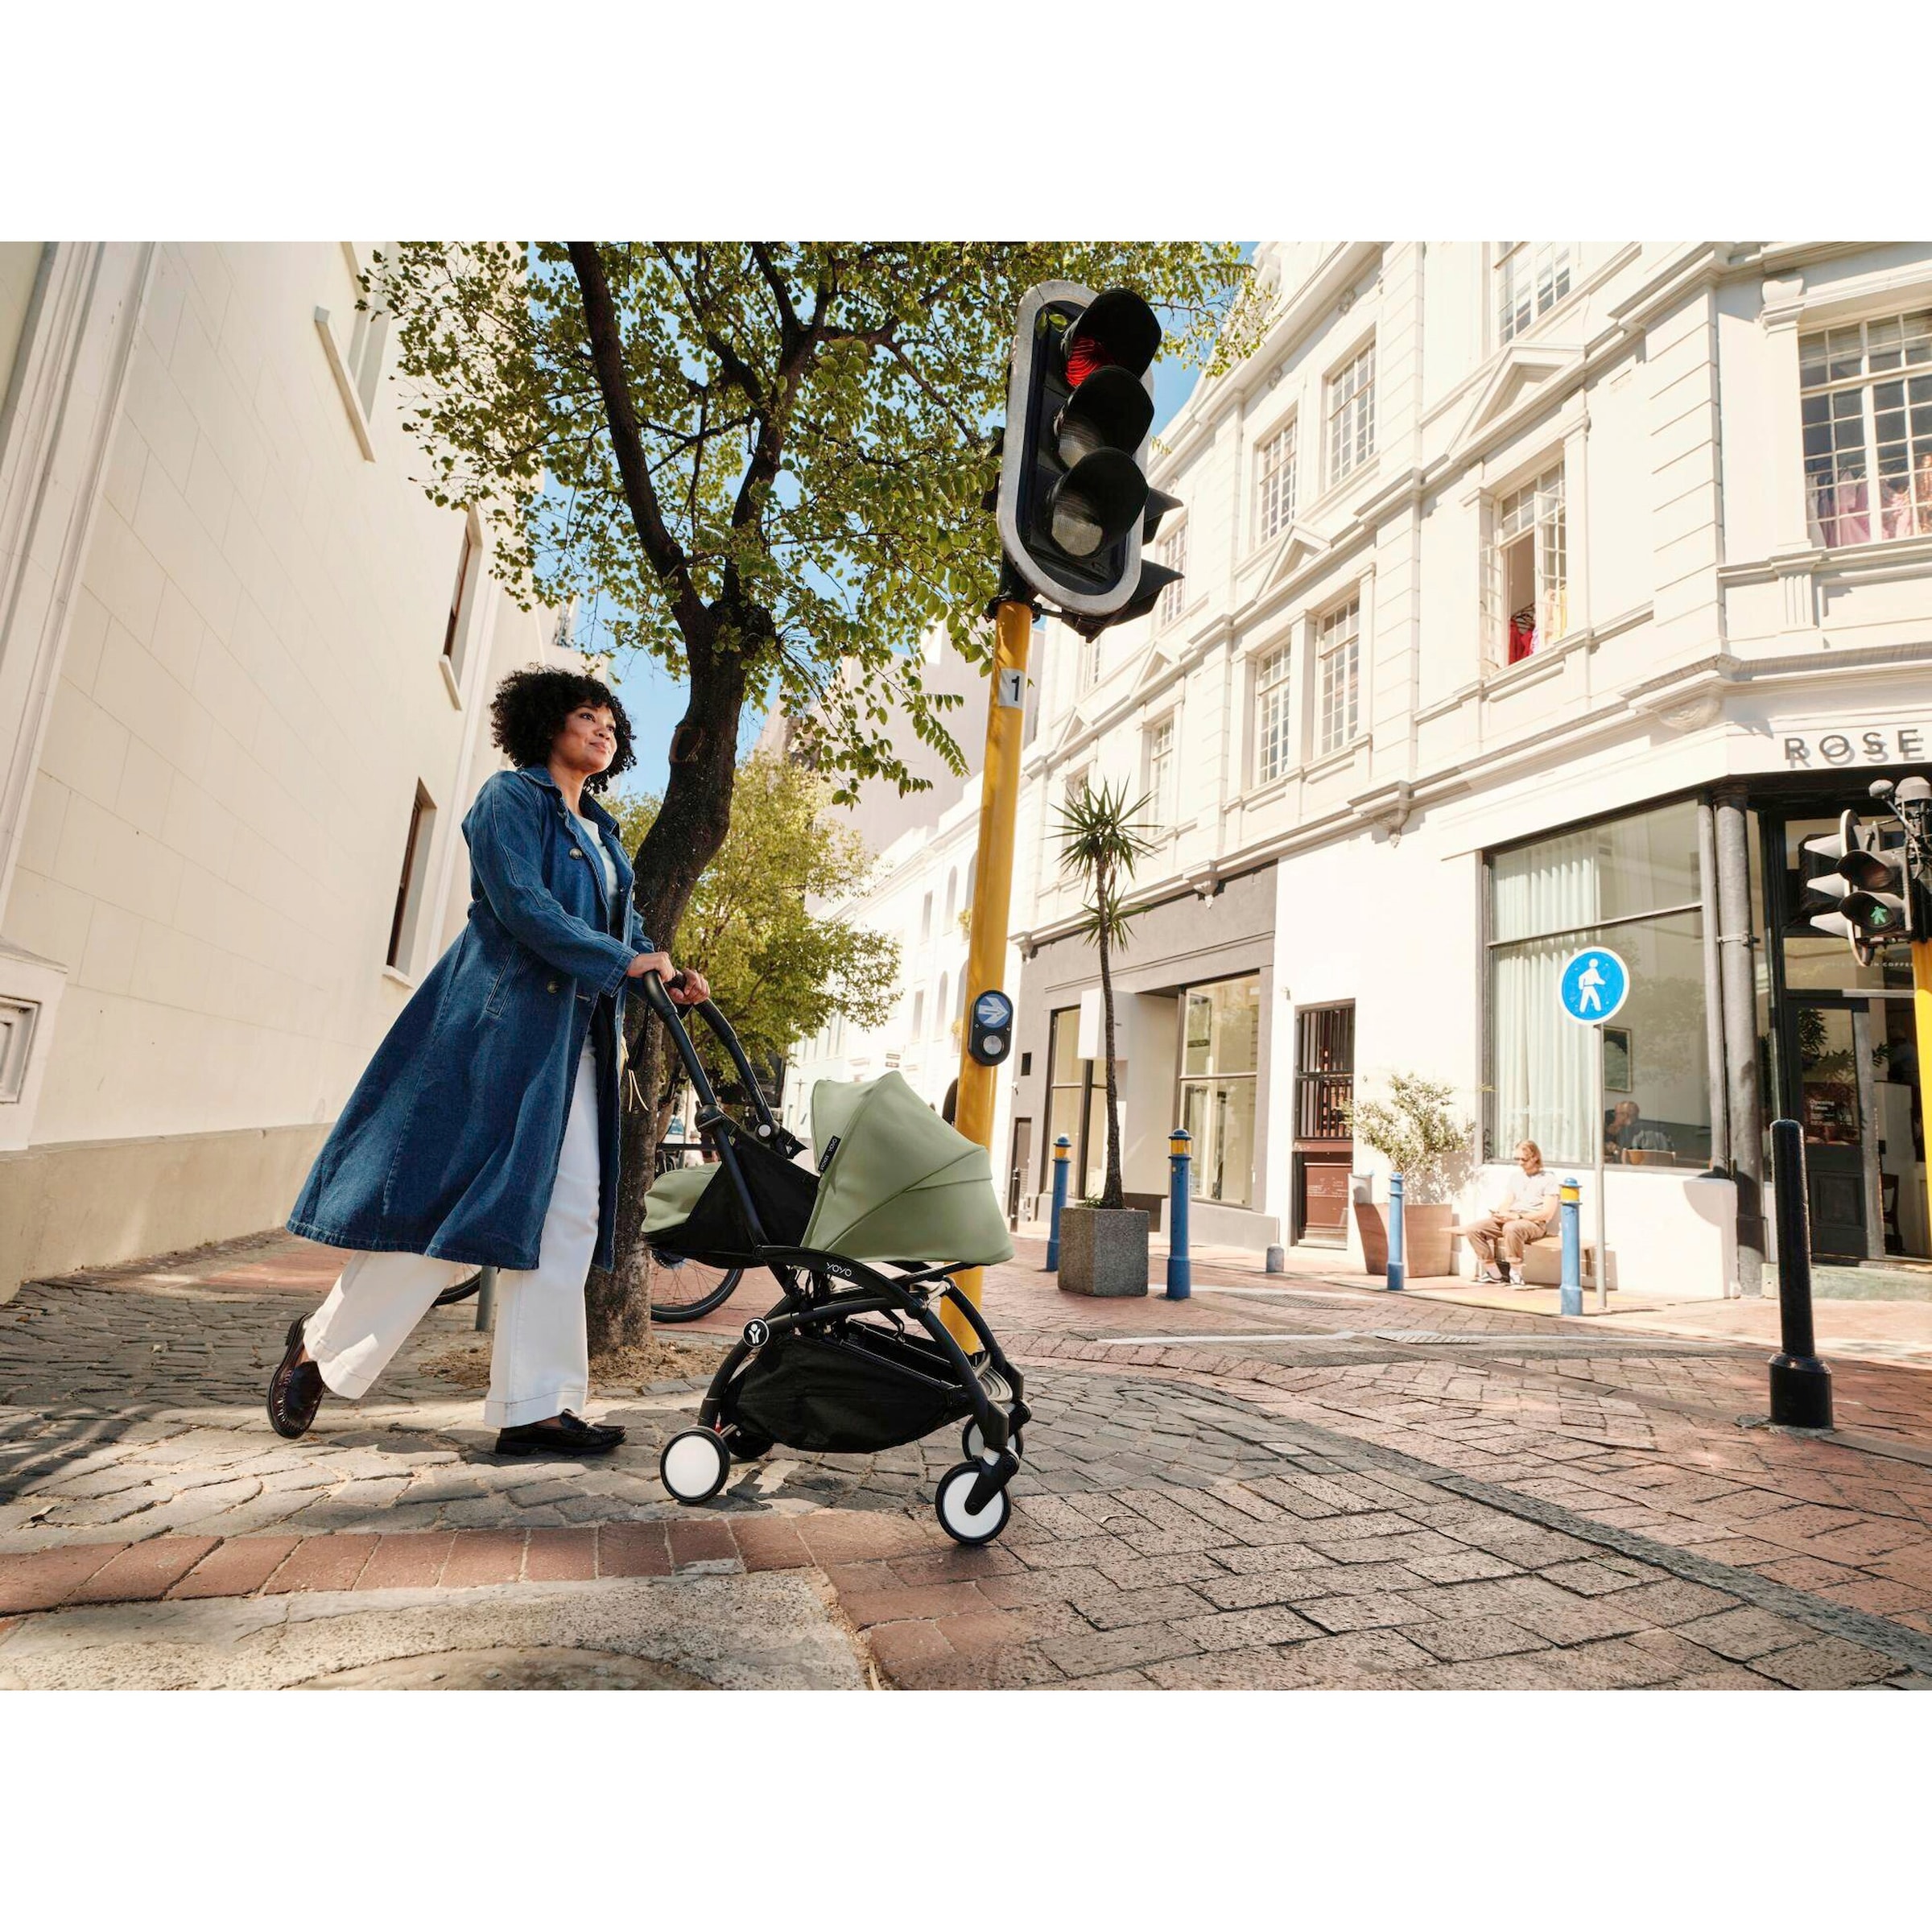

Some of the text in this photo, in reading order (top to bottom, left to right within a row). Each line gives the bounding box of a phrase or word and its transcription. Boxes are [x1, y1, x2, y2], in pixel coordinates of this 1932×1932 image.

[1011, 675, 1020, 701] 1
[1785, 729, 1922, 760] ROSE
[826, 1261, 852, 1278] YOYO
